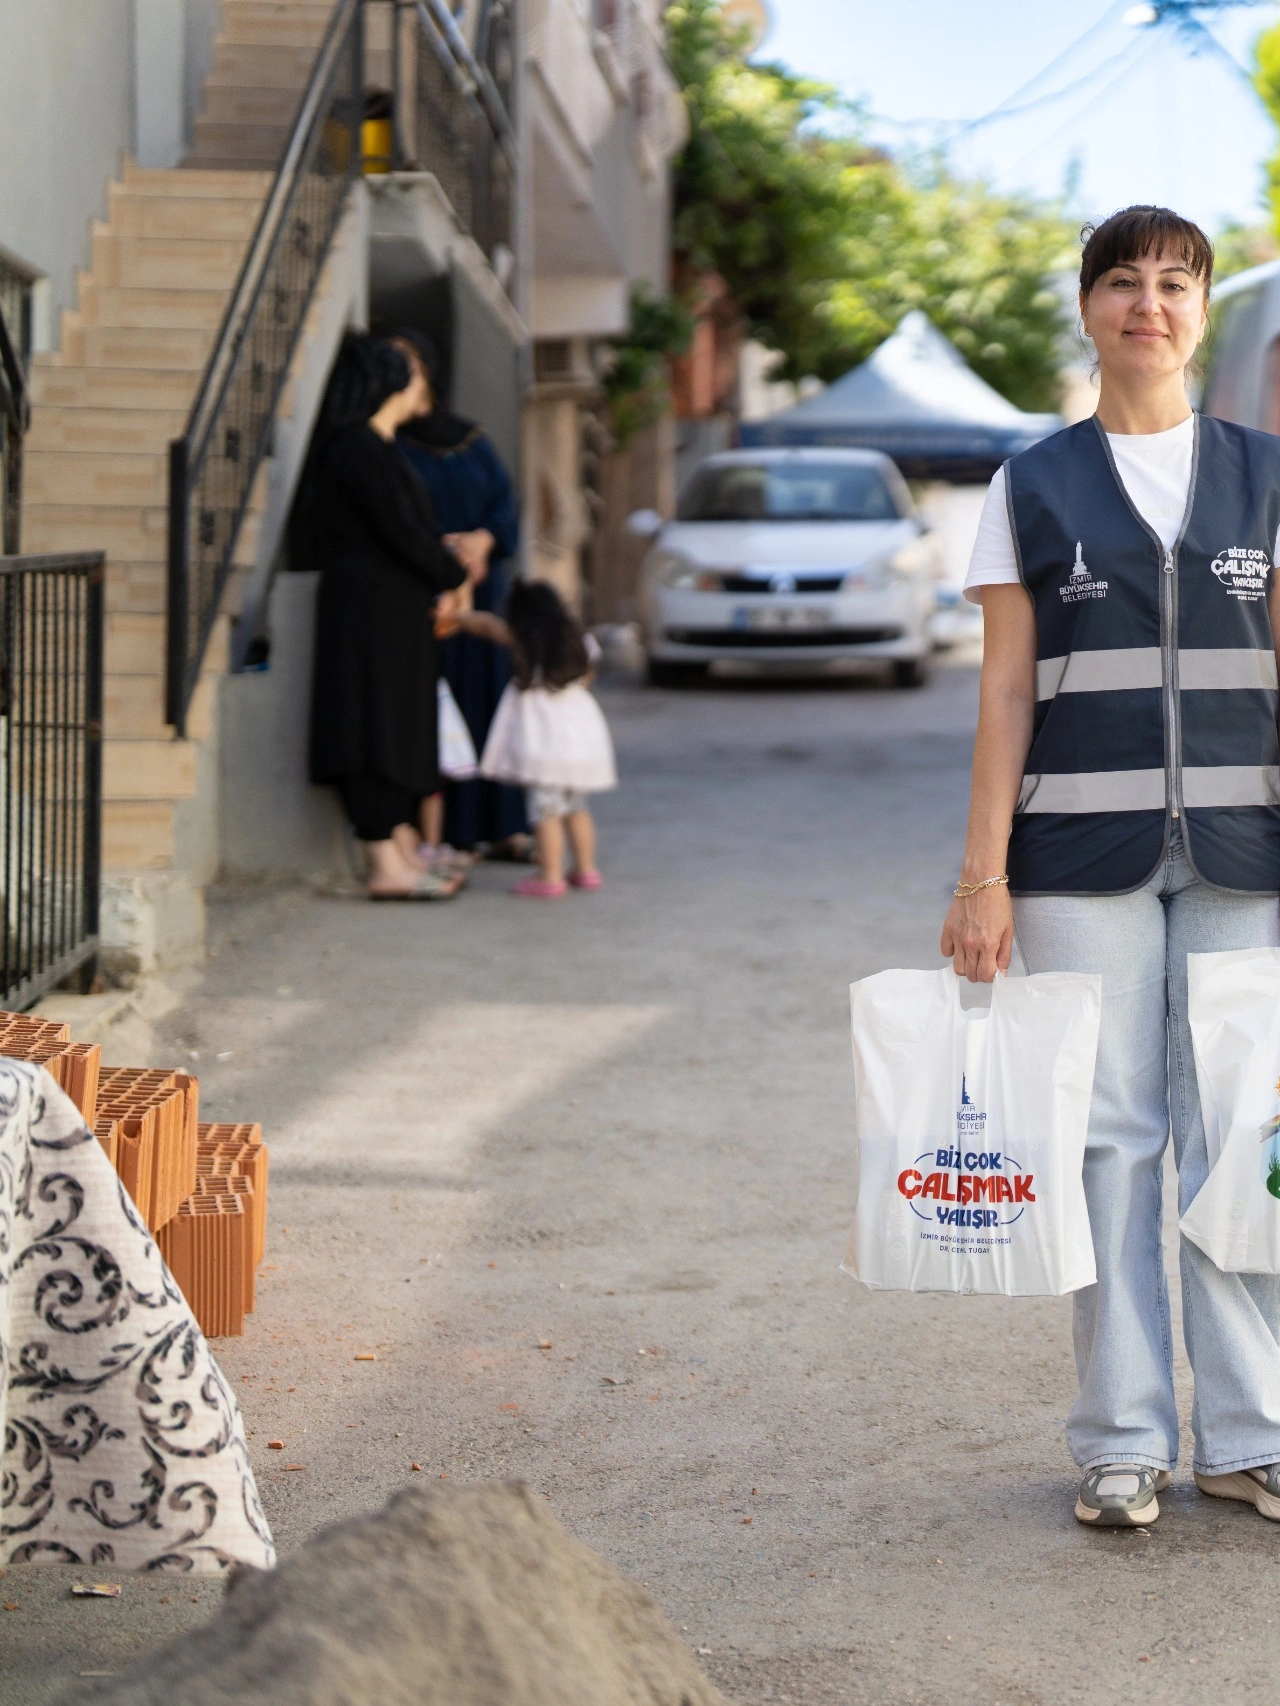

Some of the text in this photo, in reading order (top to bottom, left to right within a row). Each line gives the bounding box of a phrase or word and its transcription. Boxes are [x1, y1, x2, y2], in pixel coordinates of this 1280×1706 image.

[1059, 581, 1108, 595] BÜYÜKŞEHİR
[963, 1152, 1003, 1171] ÇOK
[897, 1169, 1036, 1206] ÇALIŞMAK
[920, 1231, 939, 1241] İZMİR
